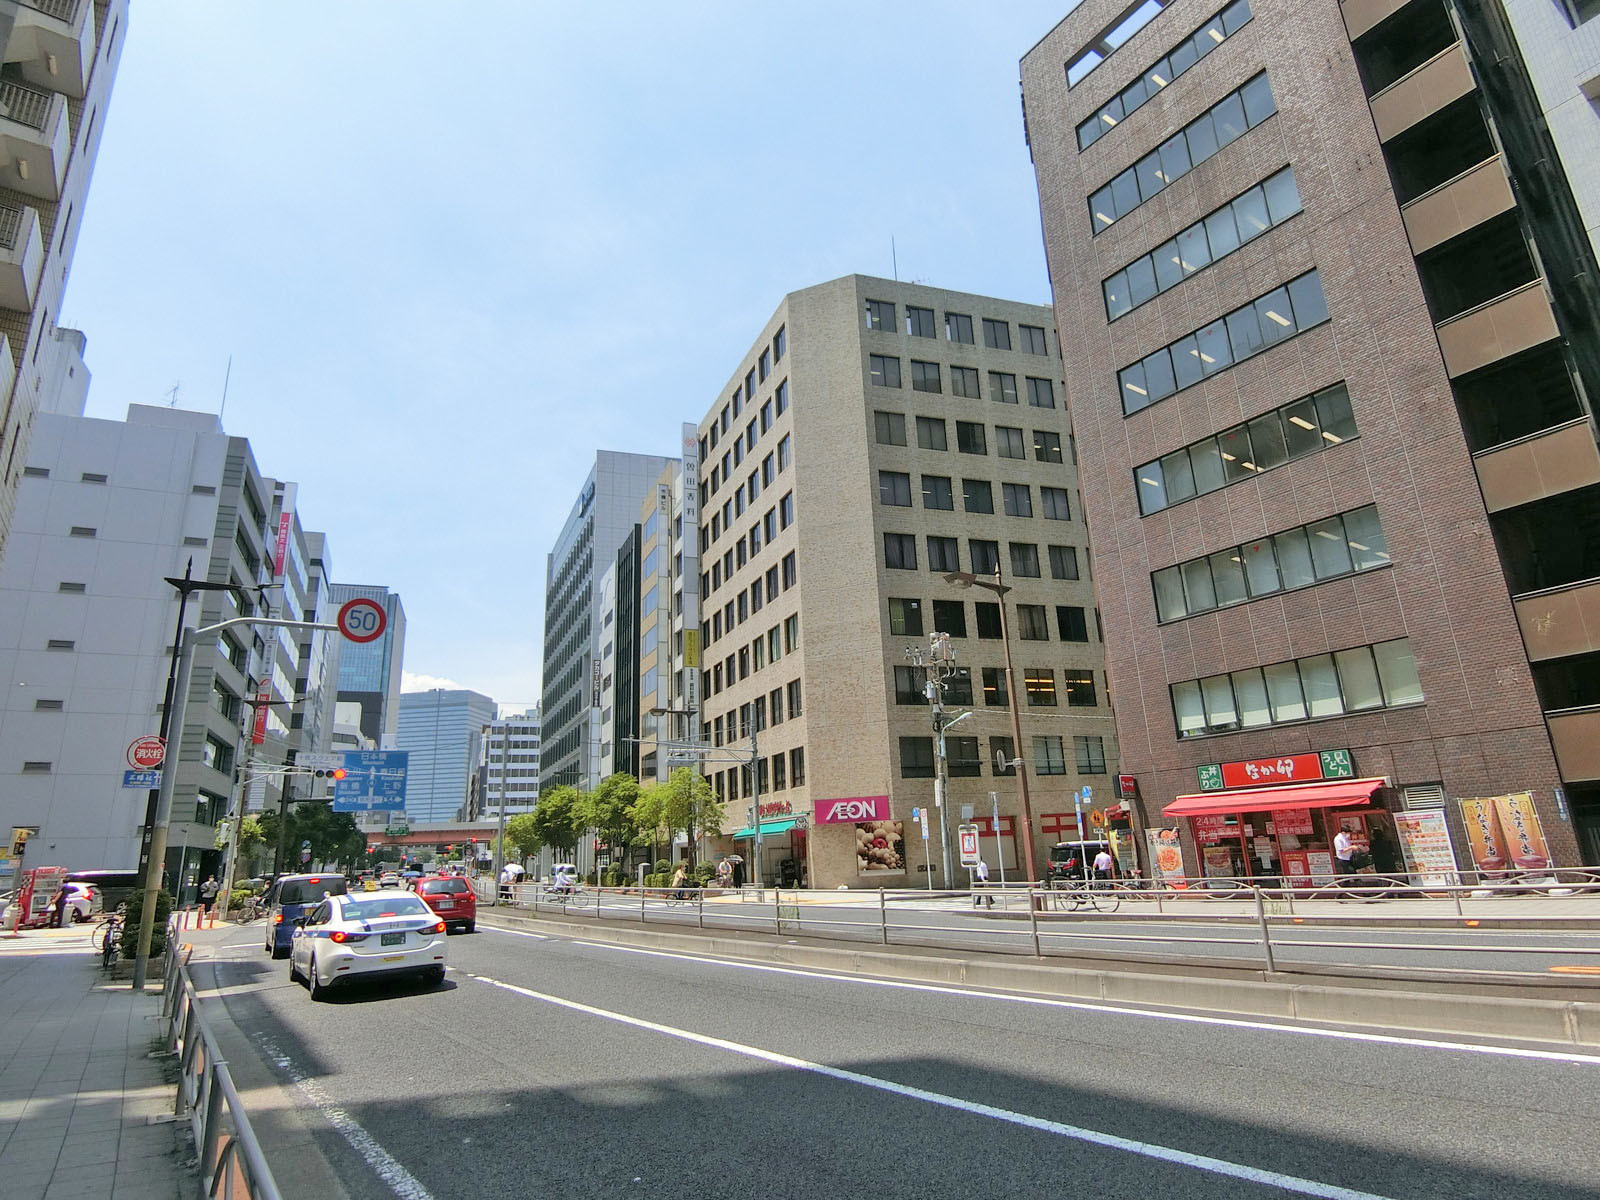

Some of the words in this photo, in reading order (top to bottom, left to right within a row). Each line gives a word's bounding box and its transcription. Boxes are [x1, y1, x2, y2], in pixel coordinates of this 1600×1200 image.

[349, 609, 376, 631] 50
[136, 748, 163, 759] 消火栓
[361, 752, 387, 760] 日本橋
[1246, 759, 1294, 780] なか卯
